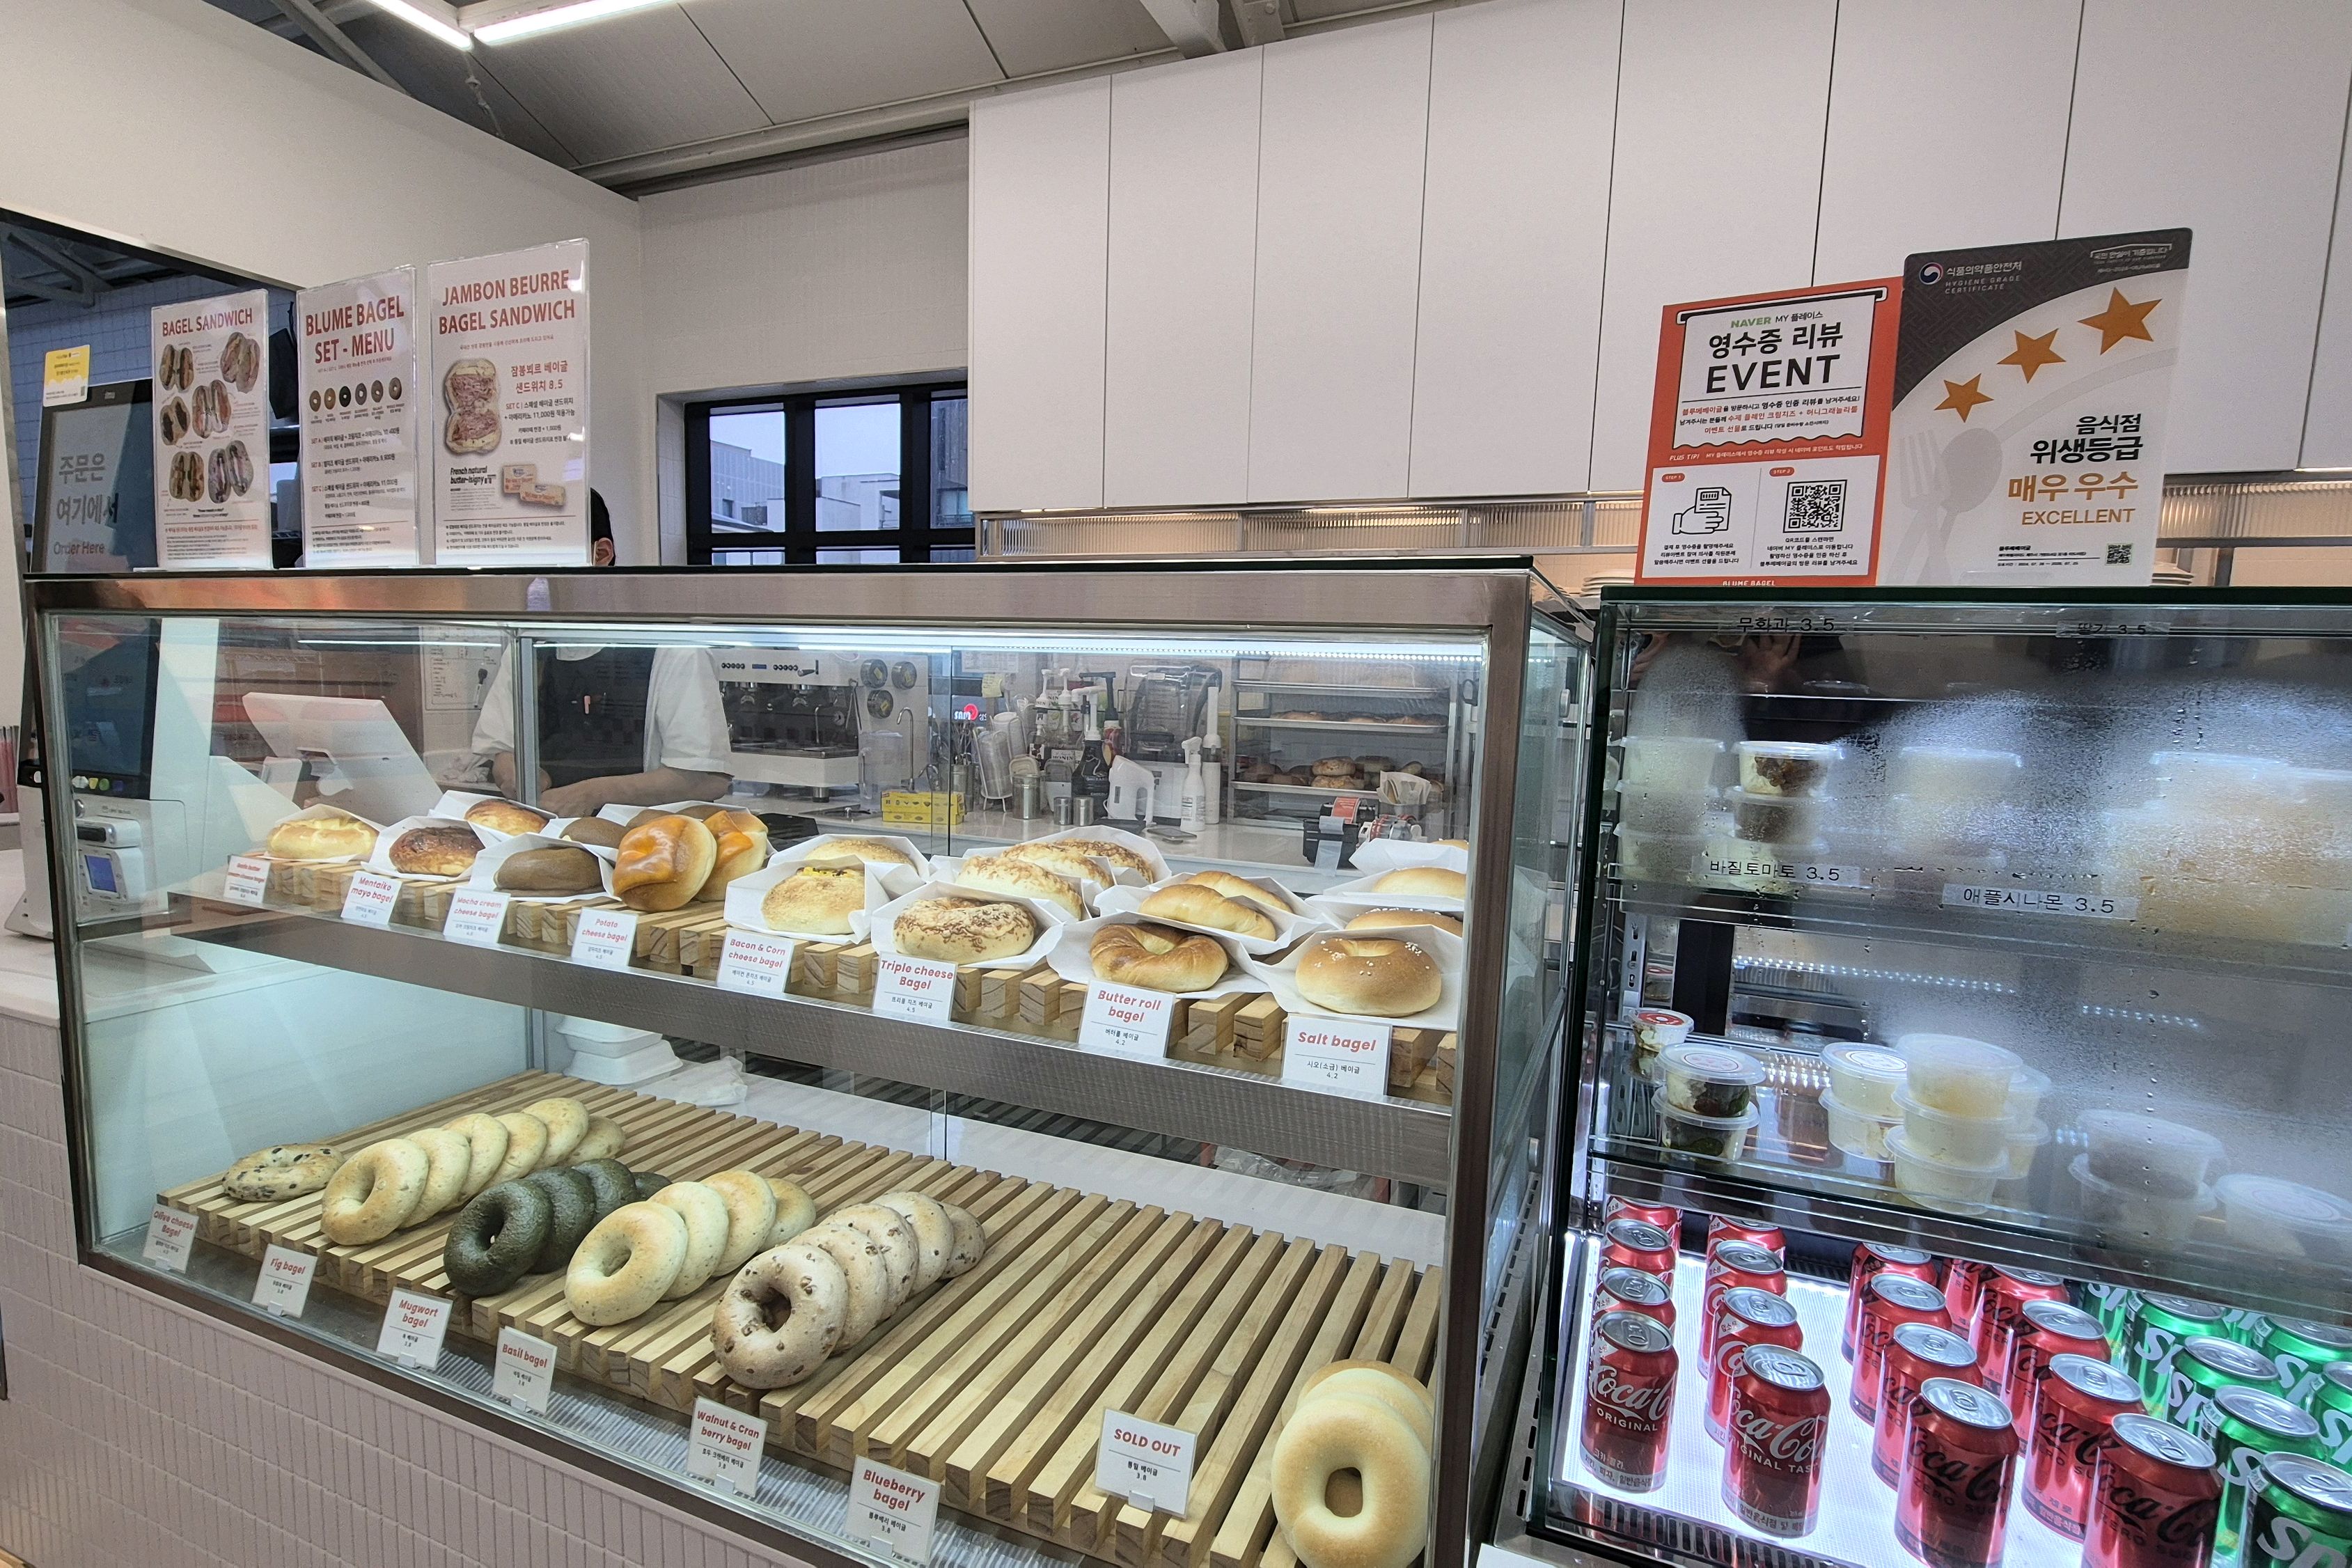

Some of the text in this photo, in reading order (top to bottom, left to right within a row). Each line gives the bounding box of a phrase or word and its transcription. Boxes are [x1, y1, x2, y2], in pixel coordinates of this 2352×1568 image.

[1946, 262, 2021, 276] 식품의약품안전처
[442, 269, 569, 306] JAMBON BEURRE
[1945, 284, 2004, 294] CERTIFICATE
[162, 308, 253, 337] BAGEL SANDWICH
[306, 295, 405, 336] BLUME BAGEL
[439, 299, 574, 334] BAGEL SANDWICH
[1731, 316, 1771, 328] NAVER
[1791, 311, 1823, 322] 플레이스
[315, 338, 340, 363] SET
[351, 328, 394, 357] MENU
[1709, 322, 1843, 360] 영수증 리뷰
[511, 361, 568, 377] 잠봉뵈르 베이글
[1707, 354, 1840, 393] EVENT
[516, 379, 563, 393] 샌드위치 8.5
[1762, 401, 1782, 409] 영수증
[1745, 412, 1764, 421] 플레인
[2076, 414, 2141, 434] 음식점
[1749, 423, 1773, 431] 드립니다
[2030, 436, 2143, 464] 위생등급
[59, 453, 104, 484] 주문은
[2008, 471, 2138, 502] 매우 우수
[56, 493, 119, 525] 여기에서
[2022, 509, 2135, 525] EXCELLENT
[54, 540, 104, 556] Order Here
[1737, 617, 1834, 632] 무화과 3.5
[1710, 860, 1840, 881] 바질토마토 3.5
[359, 877, 391, 891] Mentaiko
[351, 888, 393, 903] mayo bagel
[1963, 888, 2114, 914] 애플시나몬 3.5
[478, 911, 499, 920] bagel
[595, 919, 618, 927] Potato
[582, 929, 627, 942] cheese bagel
[730, 939, 755, 950] Bacon
[766, 946, 785, 955] Corn
[729, 952, 783, 969] cheese bagel
[881, 960, 953, 979] Triple cheese
[900, 976, 931, 990] Bagel
[1098, 990, 1161, 1010] Butter roll
[1108, 1006, 1145, 1023] bagel
[1105, 1028, 1139, 1041] 버터롤 베이글
[1298, 1032, 1377, 1053] Salt bagel
[1307, 1060, 1360, 1074] 시오(소금) 베이글
[154, 1211, 193, 1230] Olive cheese
[162, 1225, 181, 1237] Bagel
[270, 1258, 306, 1275] Fig bagel
[399, 1299, 438, 1317] Mugwort
[402, 1313, 428, 1328] bagel
[503, 1344, 547, 1367] Basil bagel
[697, 1411, 759, 1438] Walnut & Cran
[1597, 1407, 1658, 1431] ORIGINAL
[701, 1426, 751, 1450] berry bagel
[1114, 1429, 1180, 1457] SOLD OUT
[1140, 1466, 1158, 1476] 베이글
[863, 1469, 925, 1503] Blueberry
[1914, 1475, 1954, 1505] ZERO
[874, 1489, 910, 1511] bagel
[891, 1521, 906, 1532] 베이글
[2101, 1513, 2147, 1546] ZERO
